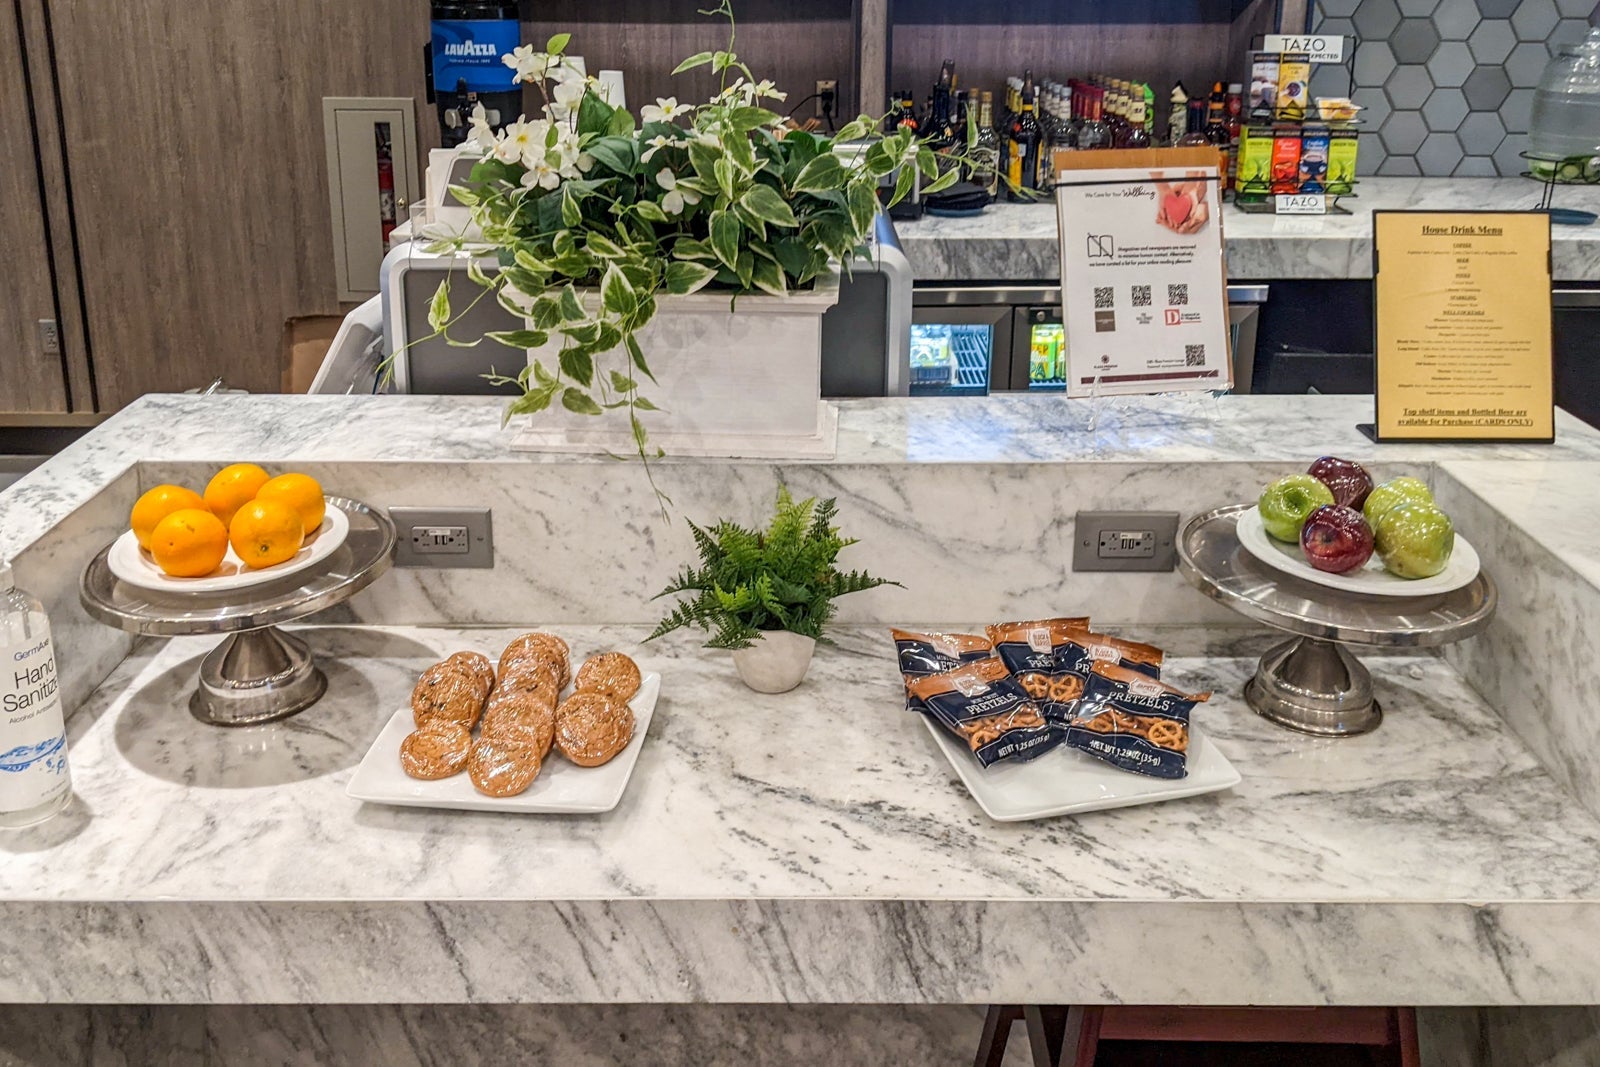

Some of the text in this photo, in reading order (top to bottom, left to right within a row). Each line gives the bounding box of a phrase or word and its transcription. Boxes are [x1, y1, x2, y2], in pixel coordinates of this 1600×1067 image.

[445, 40, 497, 56] LAVAZZA
[1281, 38, 1326, 52] TAZO
[1283, 197, 1318, 207] TAZO
[1422, 225, 1503, 236] House Drink Menu
[1403, 408, 1416, 416] Top
[1418, 408, 1435, 416] shelf
[1437, 408, 1455, 416] items
[1457, 408, 1470, 416] and
[1472, 408, 1496, 416] Bottled
[1498, 408, 1513, 416] Beer
[1397, 418, 1533, 427] available for Purchase (CARDS ONLY)
[965, 692, 1018, 715] PRETZELS
[1108, 691, 1170, 711] PRETZELS
[1090, 740, 1104, 750] NET
